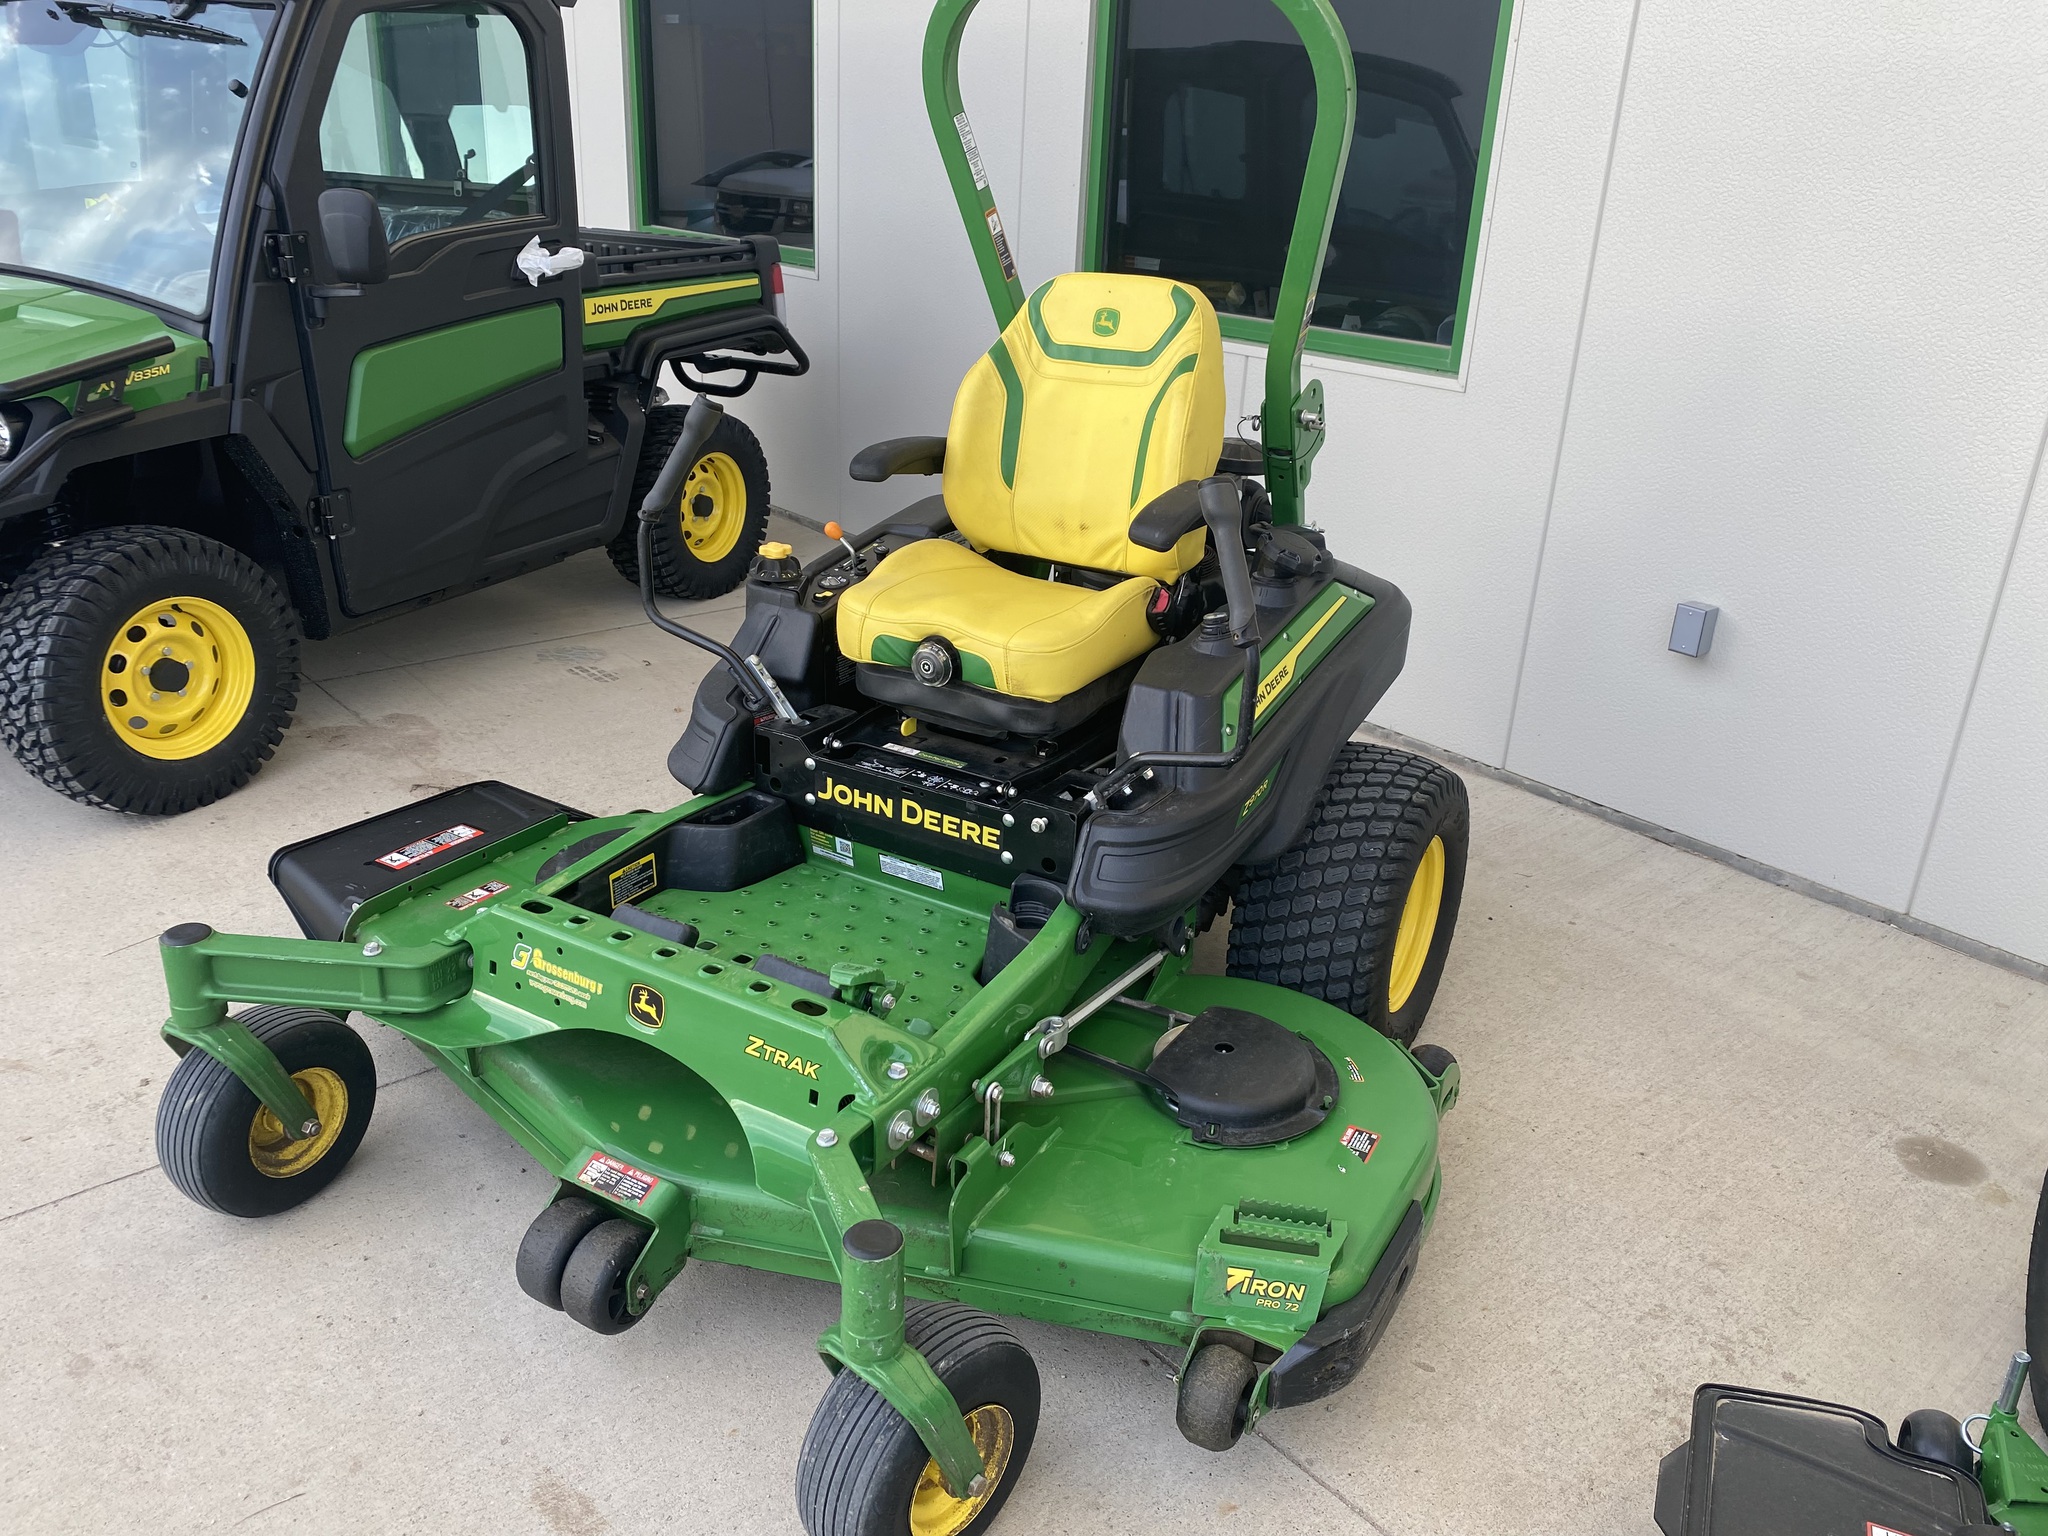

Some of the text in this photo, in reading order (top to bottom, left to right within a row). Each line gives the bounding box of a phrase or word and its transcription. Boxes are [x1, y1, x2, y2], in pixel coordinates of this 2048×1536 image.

[591, 298, 653, 315] JOHN DEERE
[1264, 665, 1289, 696] DEERE
[817, 776, 893, 819] JOHN
[901, 798, 1001, 850] DEERE
[744, 1034, 823, 1081] ZTRAK
[1255, 1298, 1300, 1312] PRO 72
